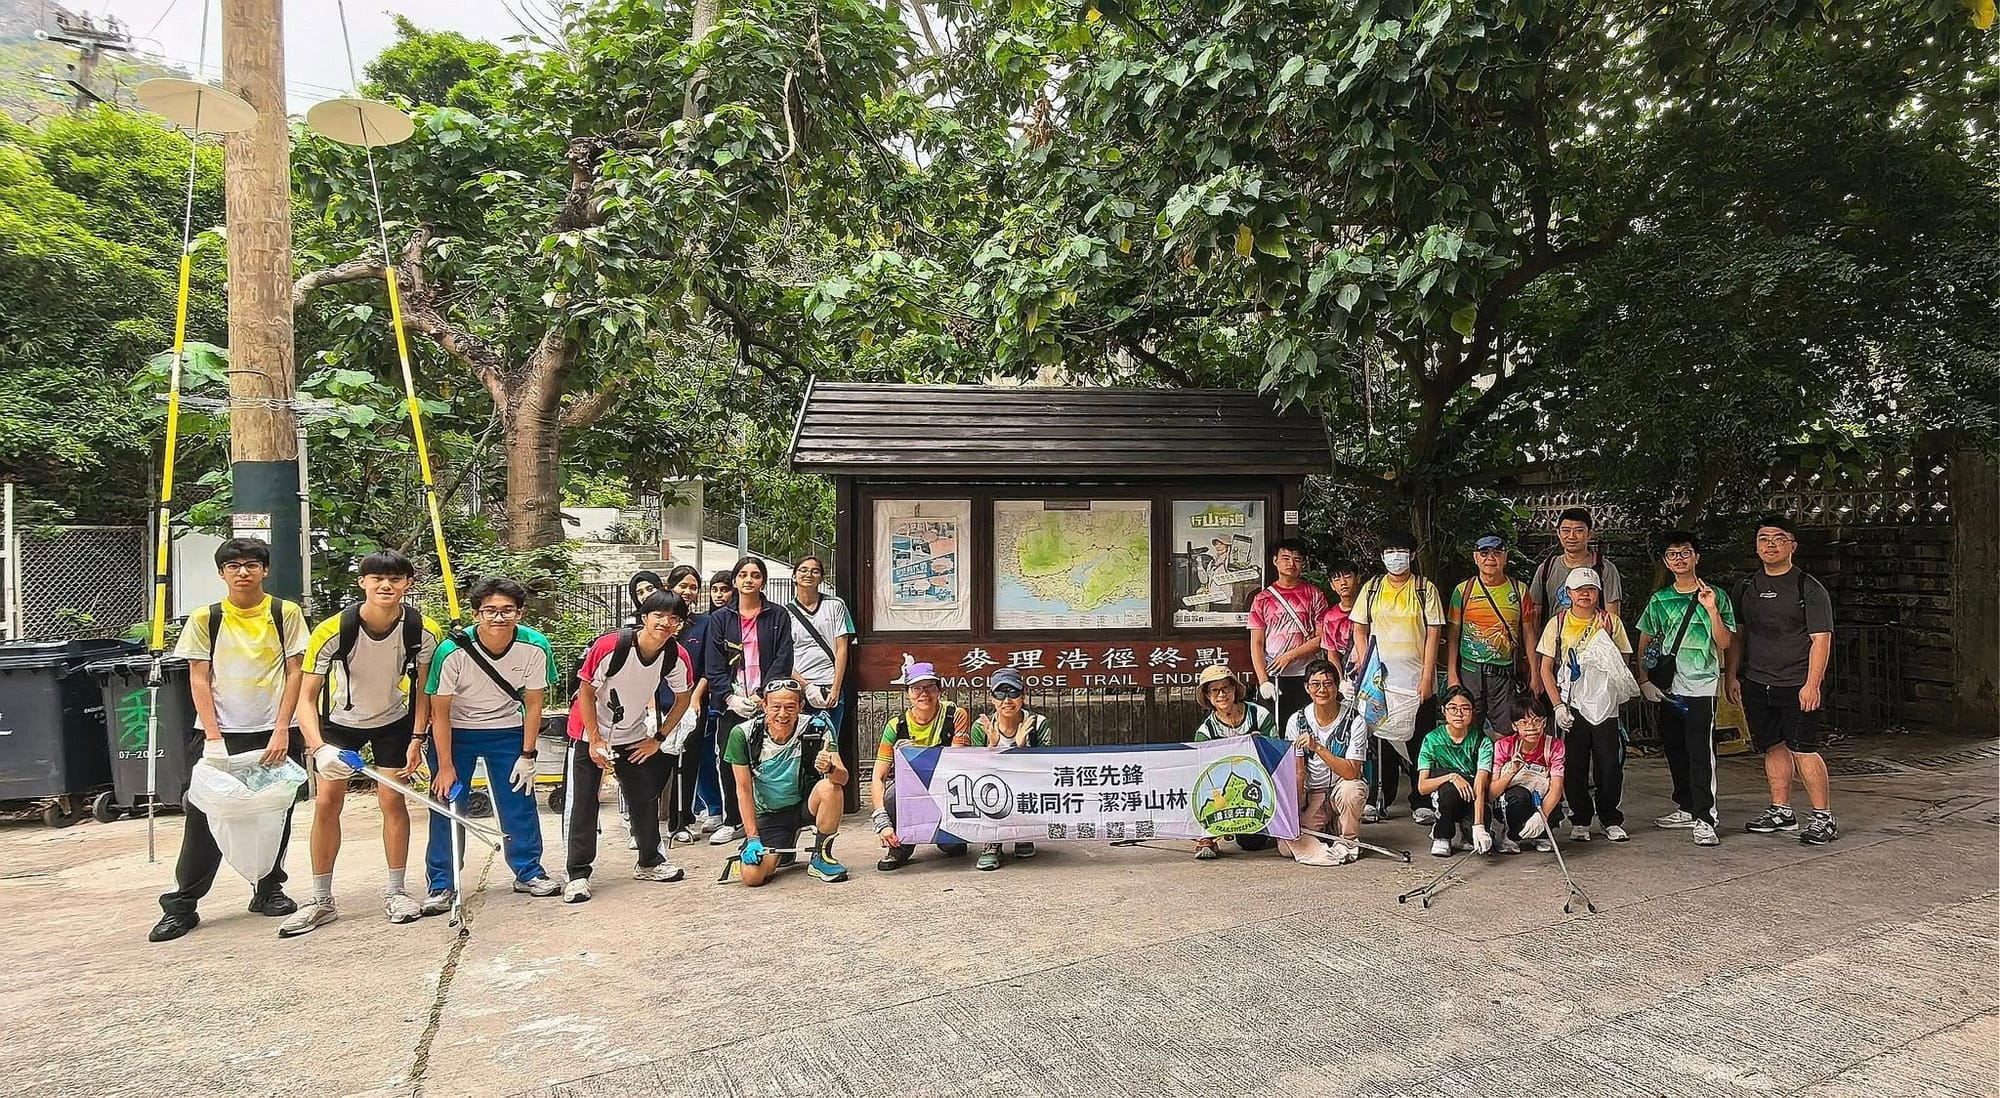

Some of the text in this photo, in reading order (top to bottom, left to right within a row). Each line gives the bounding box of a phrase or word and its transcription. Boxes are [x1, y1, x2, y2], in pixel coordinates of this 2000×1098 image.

[958, 646, 1230, 673] 麥理浩徑終點
[940, 671, 1254, 688] MACLOSE TRAIL ENDPT
[118, 749, 165, 759] 07-202
[1053, 764, 1144, 787] 清徑先鋒
[947, 773, 1188, 820] 10 載同行 潔淨山林
